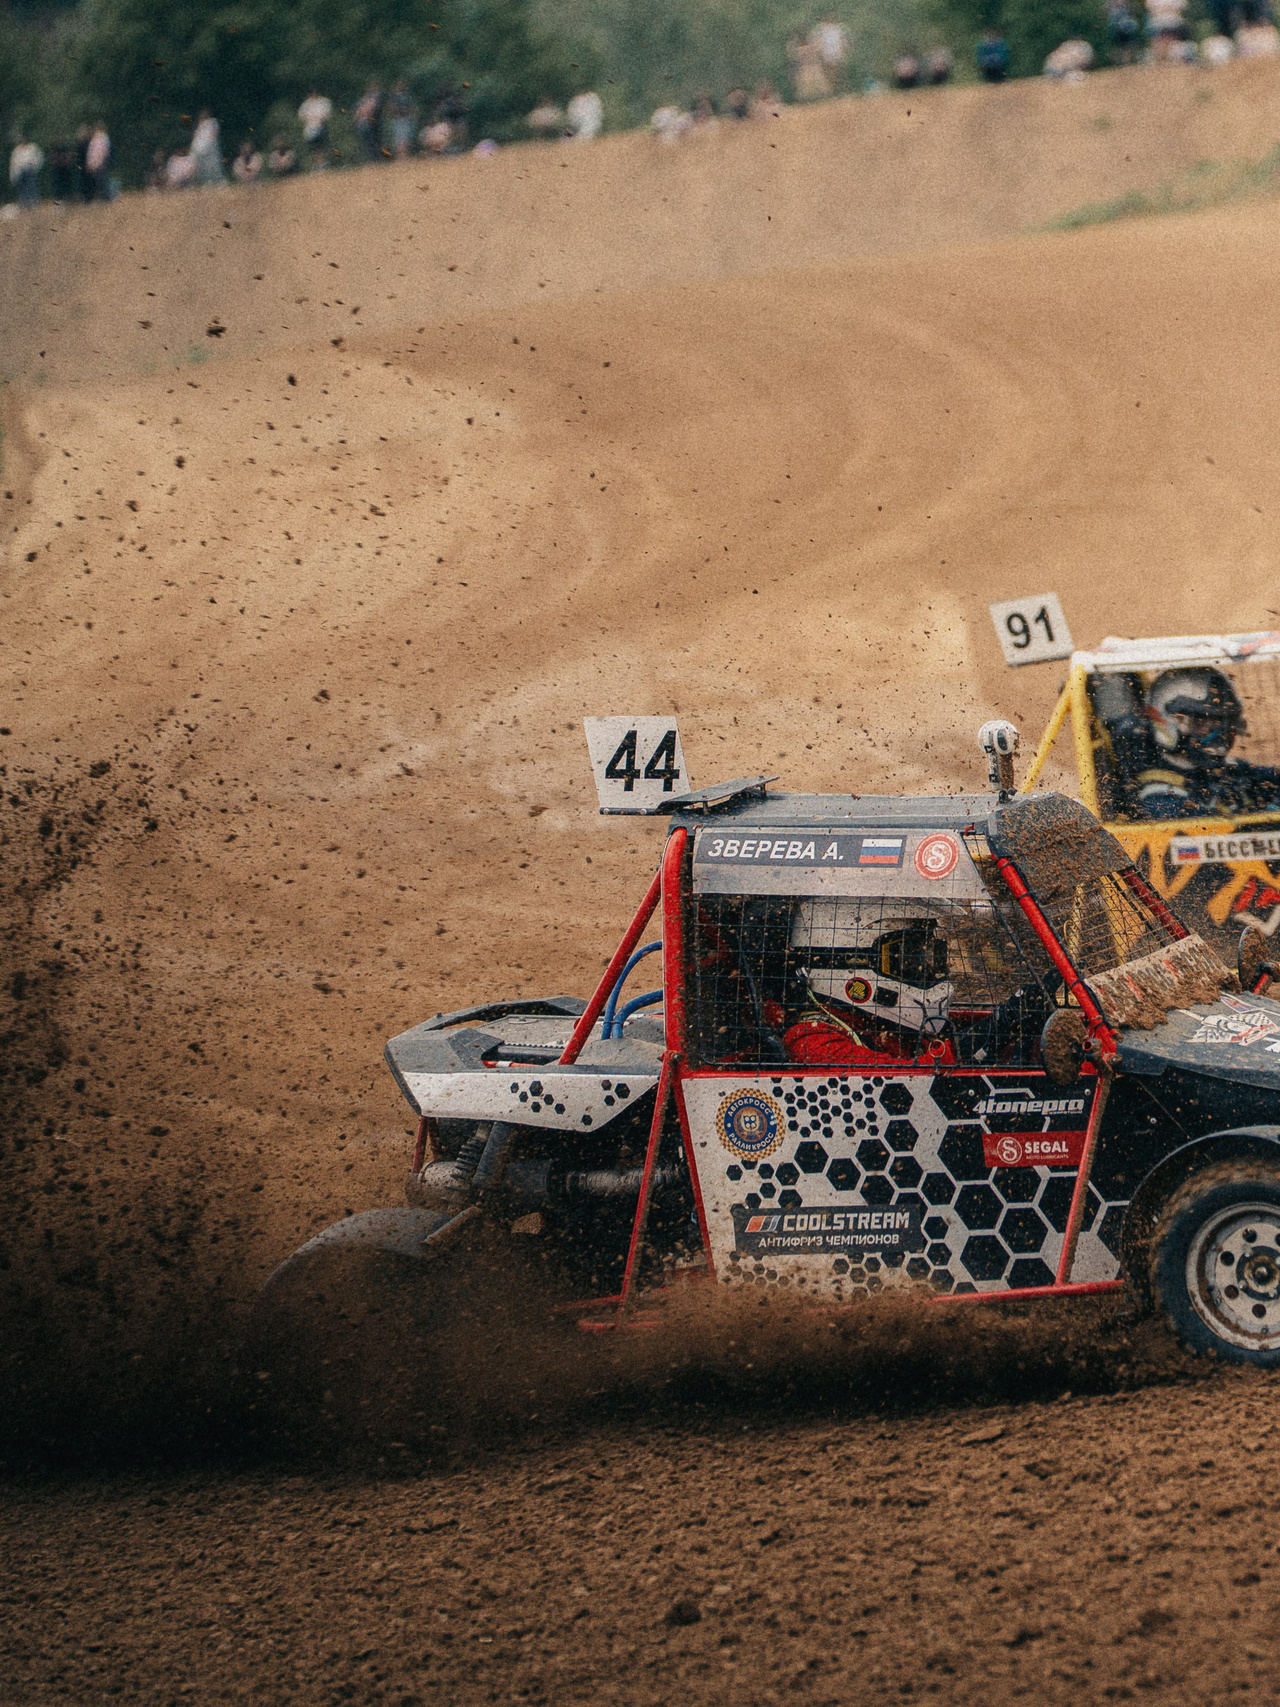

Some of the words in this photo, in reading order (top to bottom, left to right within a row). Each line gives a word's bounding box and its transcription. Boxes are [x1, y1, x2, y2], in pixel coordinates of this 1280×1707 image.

[1006, 605, 1055, 649] 91
[604, 729, 681, 792] 44
[707, 838, 816, 860] ЗВЕРЕВА
[821, 841, 844, 861] А.
[728, 1098, 771, 1117] АВТОКРОСС
[972, 1099, 1085, 1115] 4tonepro
[1024, 1140, 1069, 1154] SEGAL
[782, 1212, 910, 1232] COOLSTREAM
[758, 1235, 823, 1248] АНТИФРИЗ
[825, 1234, 900, 1247] ЧЕМПИОНОВ
